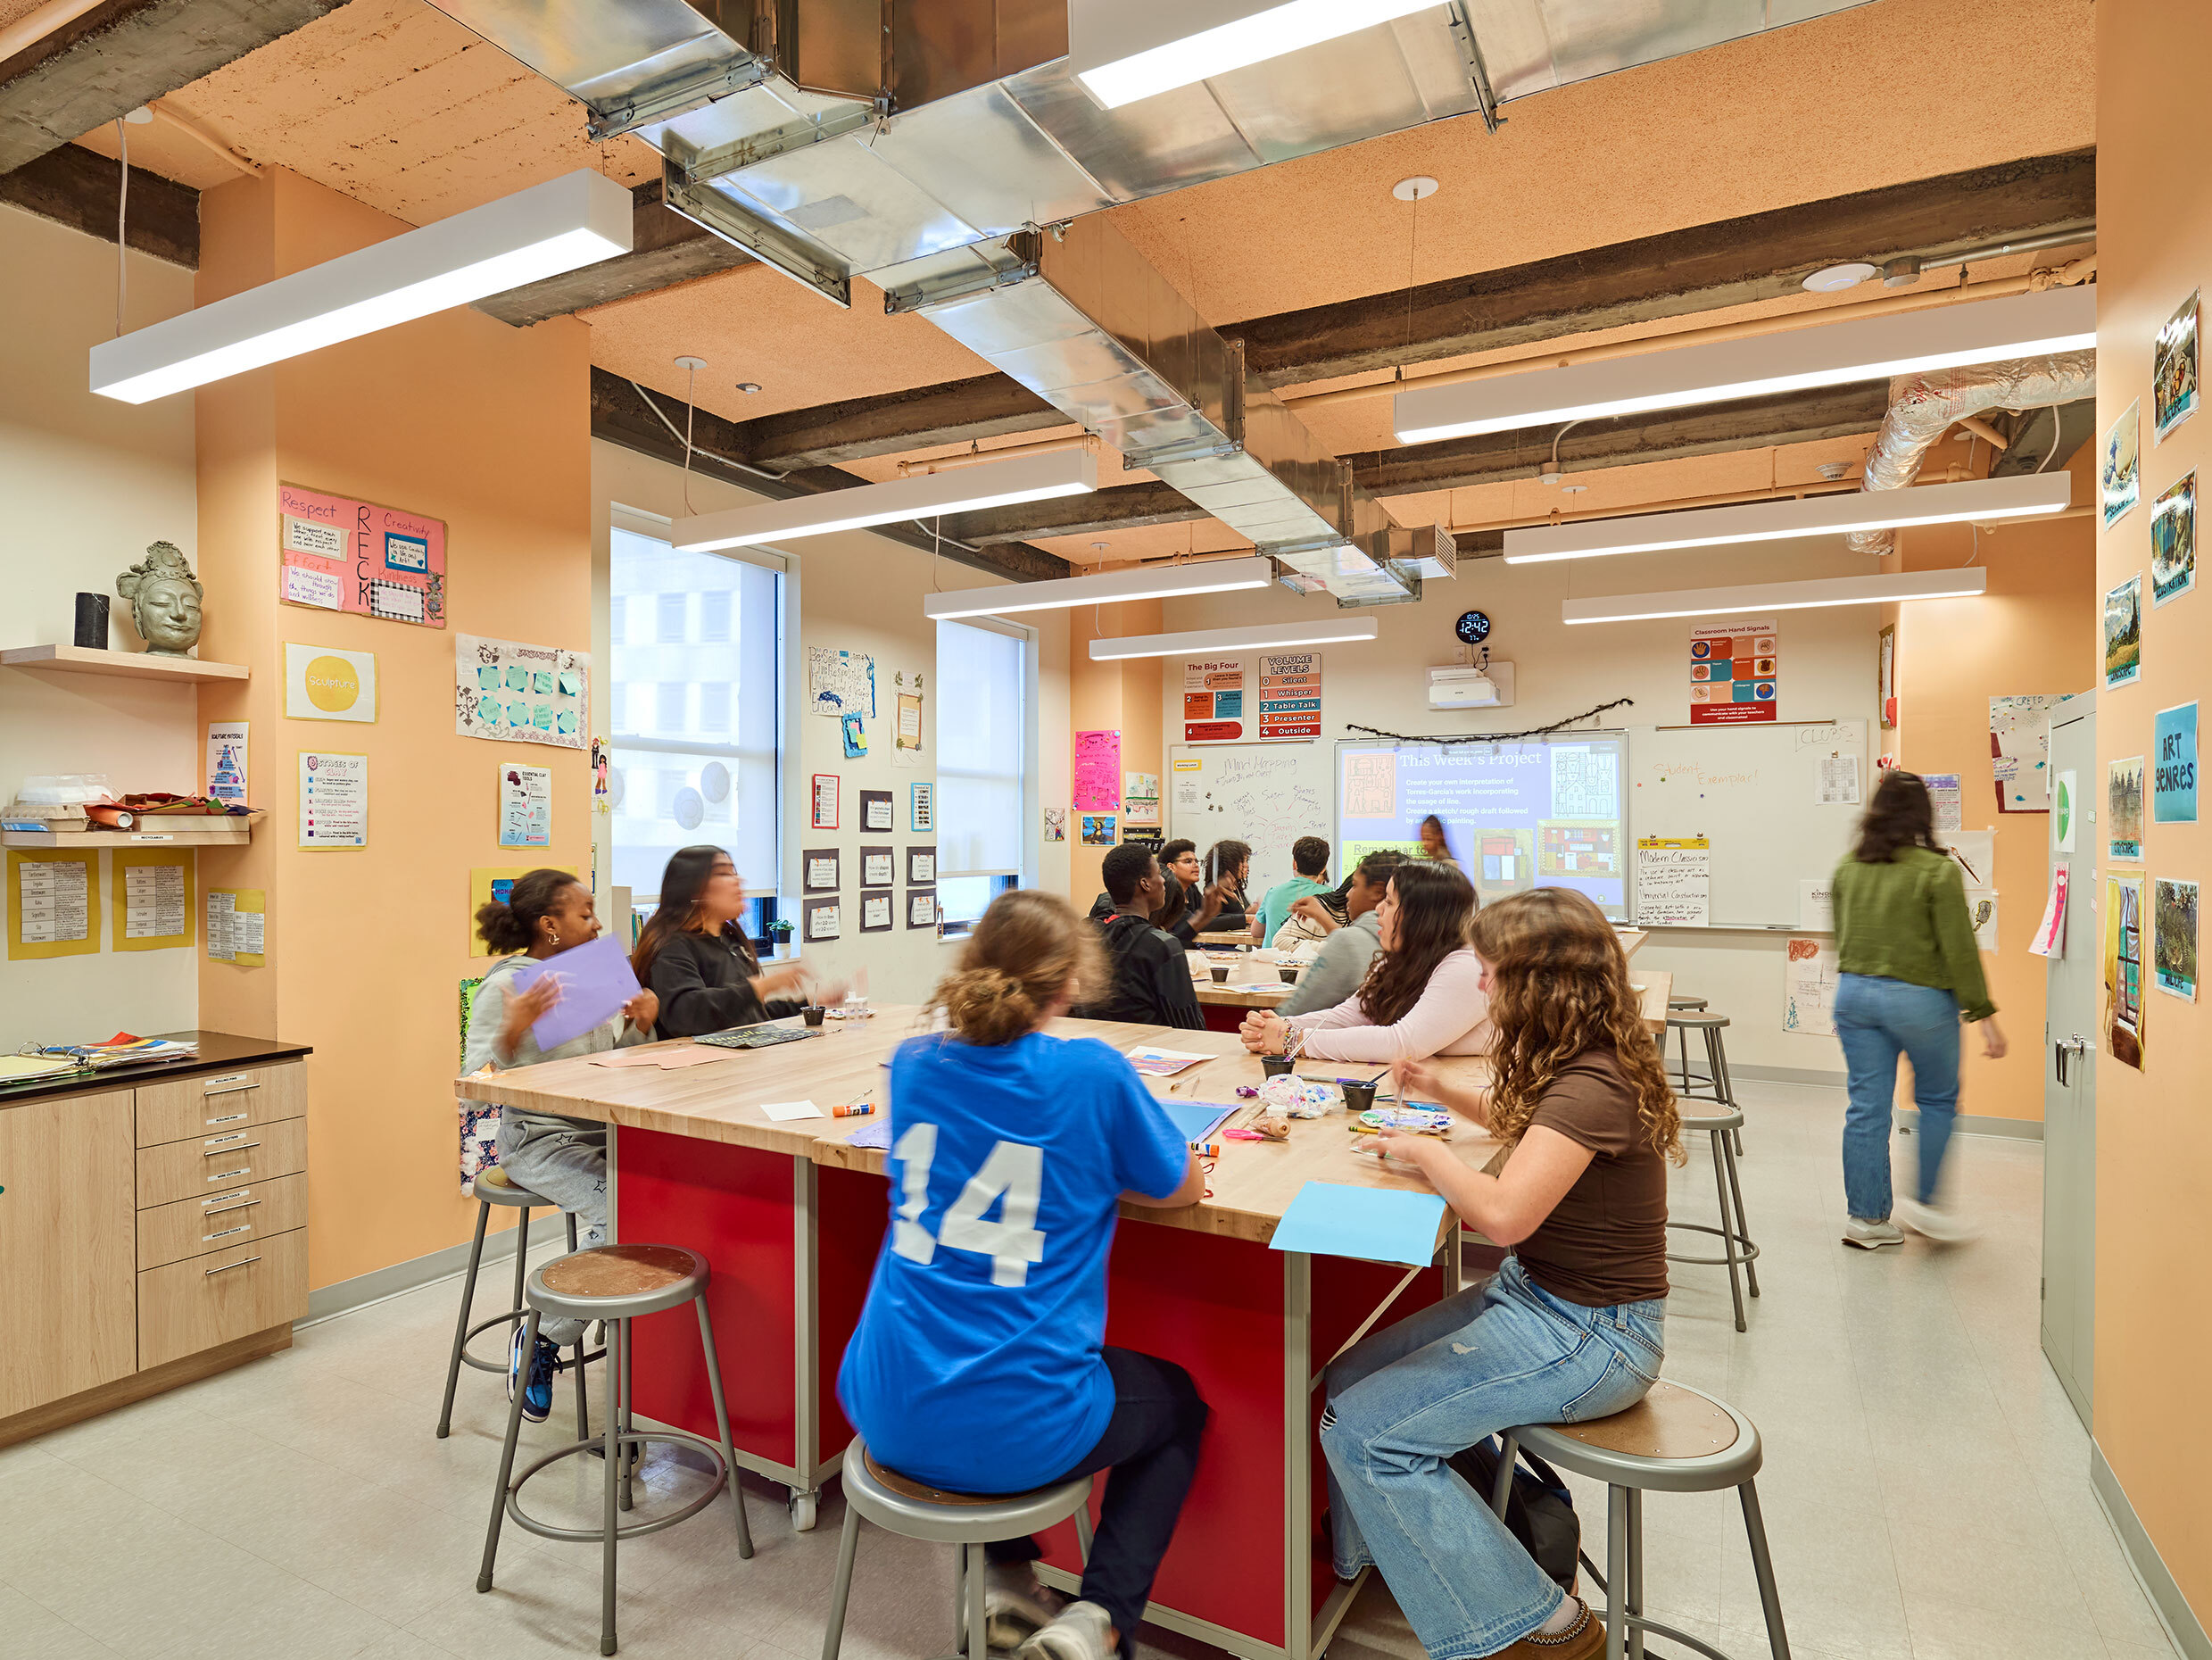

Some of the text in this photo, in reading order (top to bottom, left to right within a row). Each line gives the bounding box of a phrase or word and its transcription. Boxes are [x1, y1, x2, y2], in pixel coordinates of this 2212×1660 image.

[283, 492, 336, 519] Respect
[385, 512, 429, 538] Creativity
[284, 554, 332, 570] Effort
[378, 567, 417, 583] Kindness
[1459, 621, 1488, 634] 12:42
[808, 646, 821, 662] Be
[1268, 655, 1312, 666] VOLUME
[1205, 663, 1217, 671] Big
[1271, 666, 1309, 675] LEVELS
[309, 676, 355, 689] Sculpture
[1282, 676, 1307, 685] Silent
[1263, 689, 1313, 699] 1 Whisper
[2017, 696, 2044, 706] CREED
[1263, 703, 1270, 711] 2
[1263, 715, 1269, 723] 3
[1262, 727, 1270, 735] 4
[2163, 733, 2182, 761] ART
[319, 759, 346, 768] STAGES
[1399, 754, 1430, 768] This
[1490, 752, 1542, 768] Project
[1224, 756, 1297, 776] Mind Mapping
[1653, 762, 1700, 776] Student
[326, 768, 347, 776] CLAY
[1698, 769, 1758, 786] Exemplar!
[1459, 778, 1505, 787] interpretation
[1472, 787, 1519, 796] incorporating
[1355, 844, 1413, 853] Remember
[1640, 851, 1709, 863] Modern Classicism
[1640, 889, 1669, 900] Universal
[891, 1123, 1047, 1288] 14
